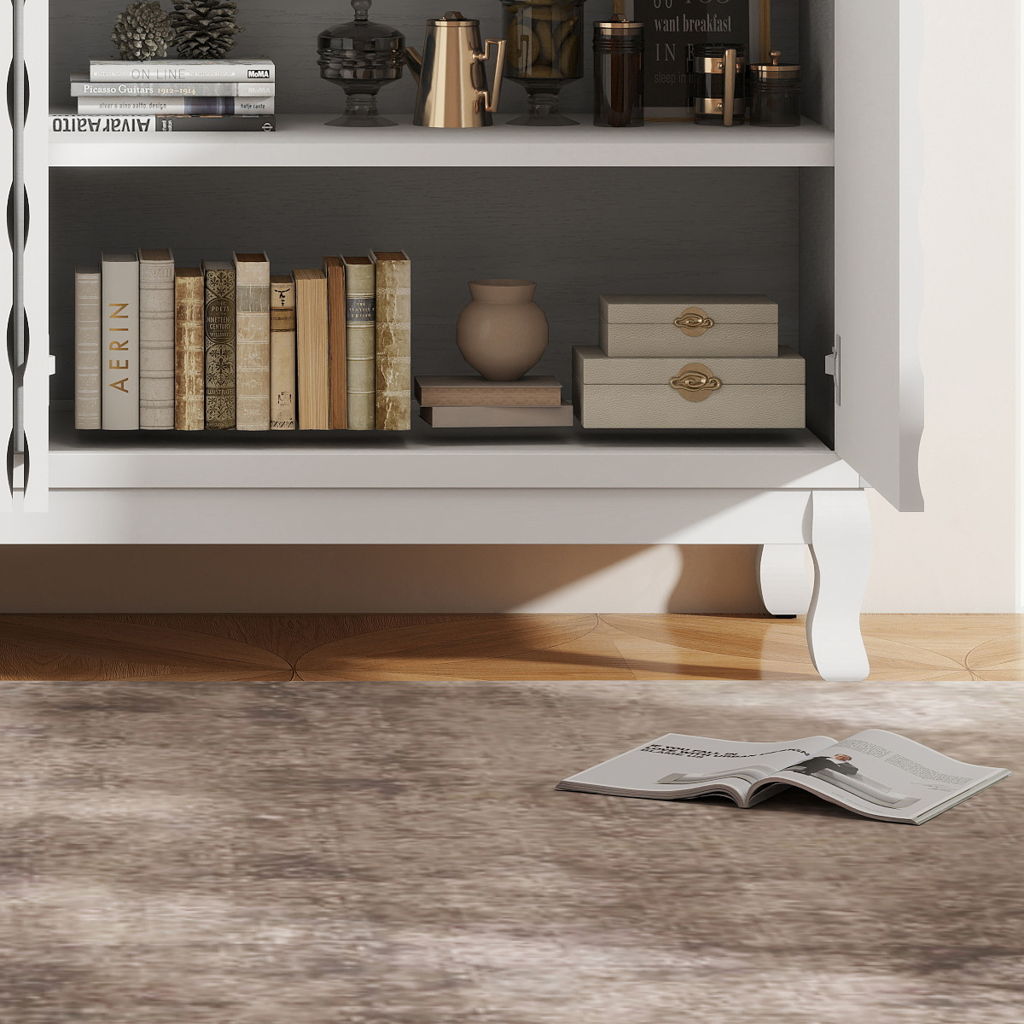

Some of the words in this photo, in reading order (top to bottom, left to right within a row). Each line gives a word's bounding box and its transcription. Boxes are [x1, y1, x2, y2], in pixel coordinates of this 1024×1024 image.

[654, 16, 680, 32] want
[682, 14, 732, 32] breakfast
[656, 43, 676, 62] IN
[157, 68, 186, 80] LINE
[248, 70, 270, 79] MoMA
[83, 84, 116, 94] Picasso
[118, 84, 154, 94] Guitars
[108, 302, 130, 393] AERIN
